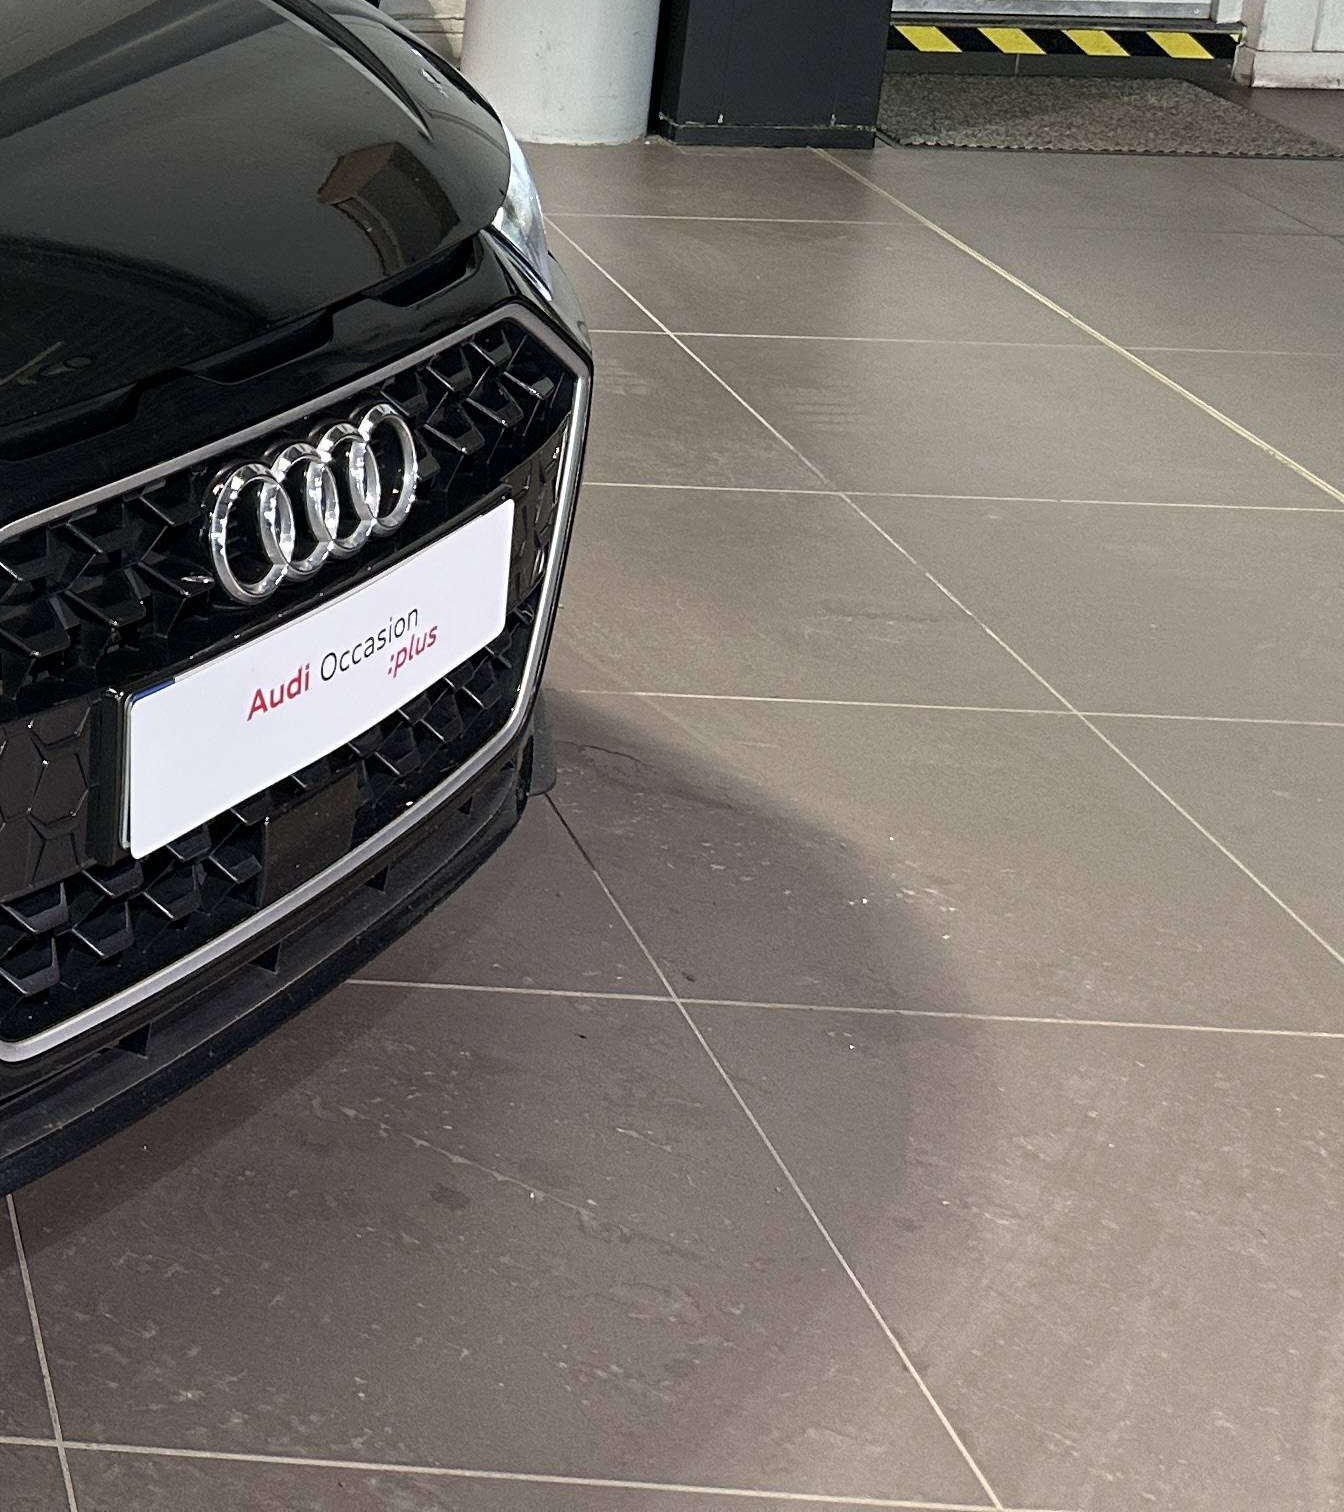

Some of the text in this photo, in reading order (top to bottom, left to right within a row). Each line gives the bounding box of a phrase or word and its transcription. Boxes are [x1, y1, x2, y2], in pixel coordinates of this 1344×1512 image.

[246, 608, 419, 722] Audi Occasion
[387, 625, 439, 679] :plus
